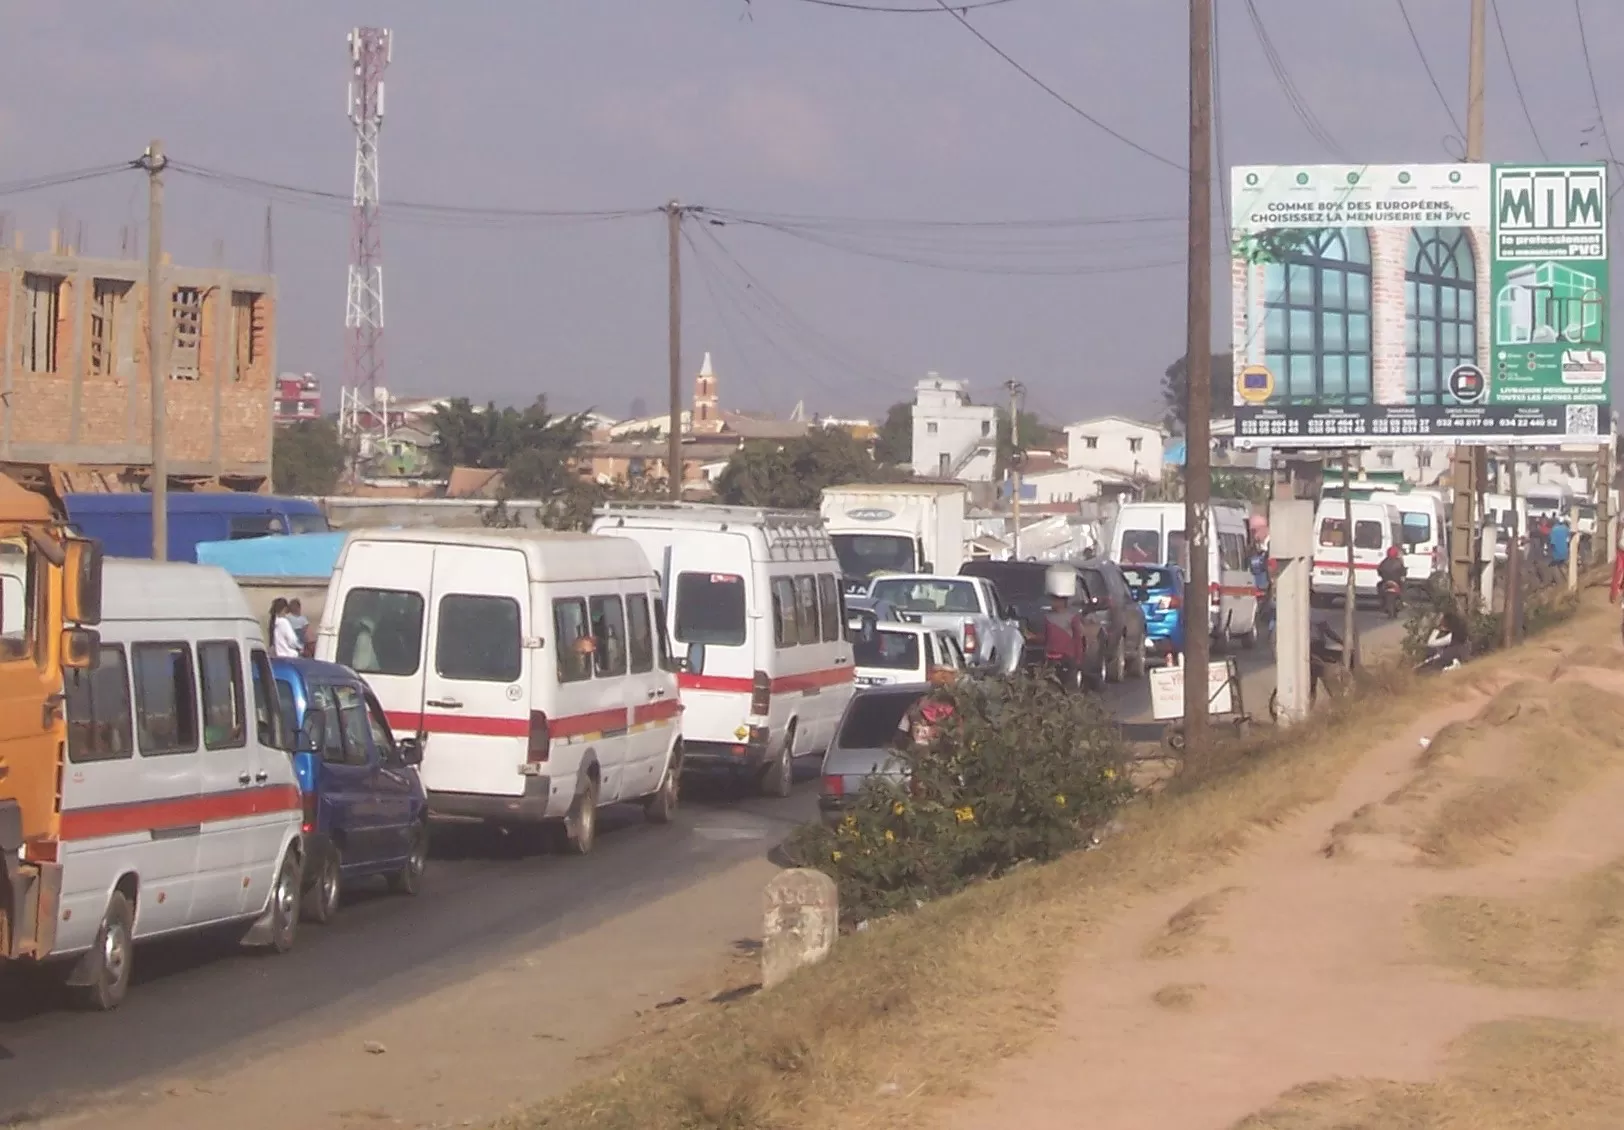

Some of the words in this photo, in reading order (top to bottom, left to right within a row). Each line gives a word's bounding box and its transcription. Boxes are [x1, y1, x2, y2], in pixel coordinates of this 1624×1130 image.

[1267, 202, 1315, 212] COMME
[1318, 202, 1343, 211] 80%
[1347, 201, 1371, 210] DES
[1376, 199, 1454, 211] EUROPÉENS,
[1251, 213, 1324, 222] CHOISISSEZ
[1326, 212, 1343, 221] LA
[1347, 211, 1420, 221] MENUISERIE
[1425, 211, 1442, 221] EN
[1446, 211, 1471, 221] PVC
[1515, 234, 1600, 246] professionnel
[1568, 244, 1601, 256] PVC
[853, 510, 890, 518] JAC
[847, 585, 867, 594] JA
